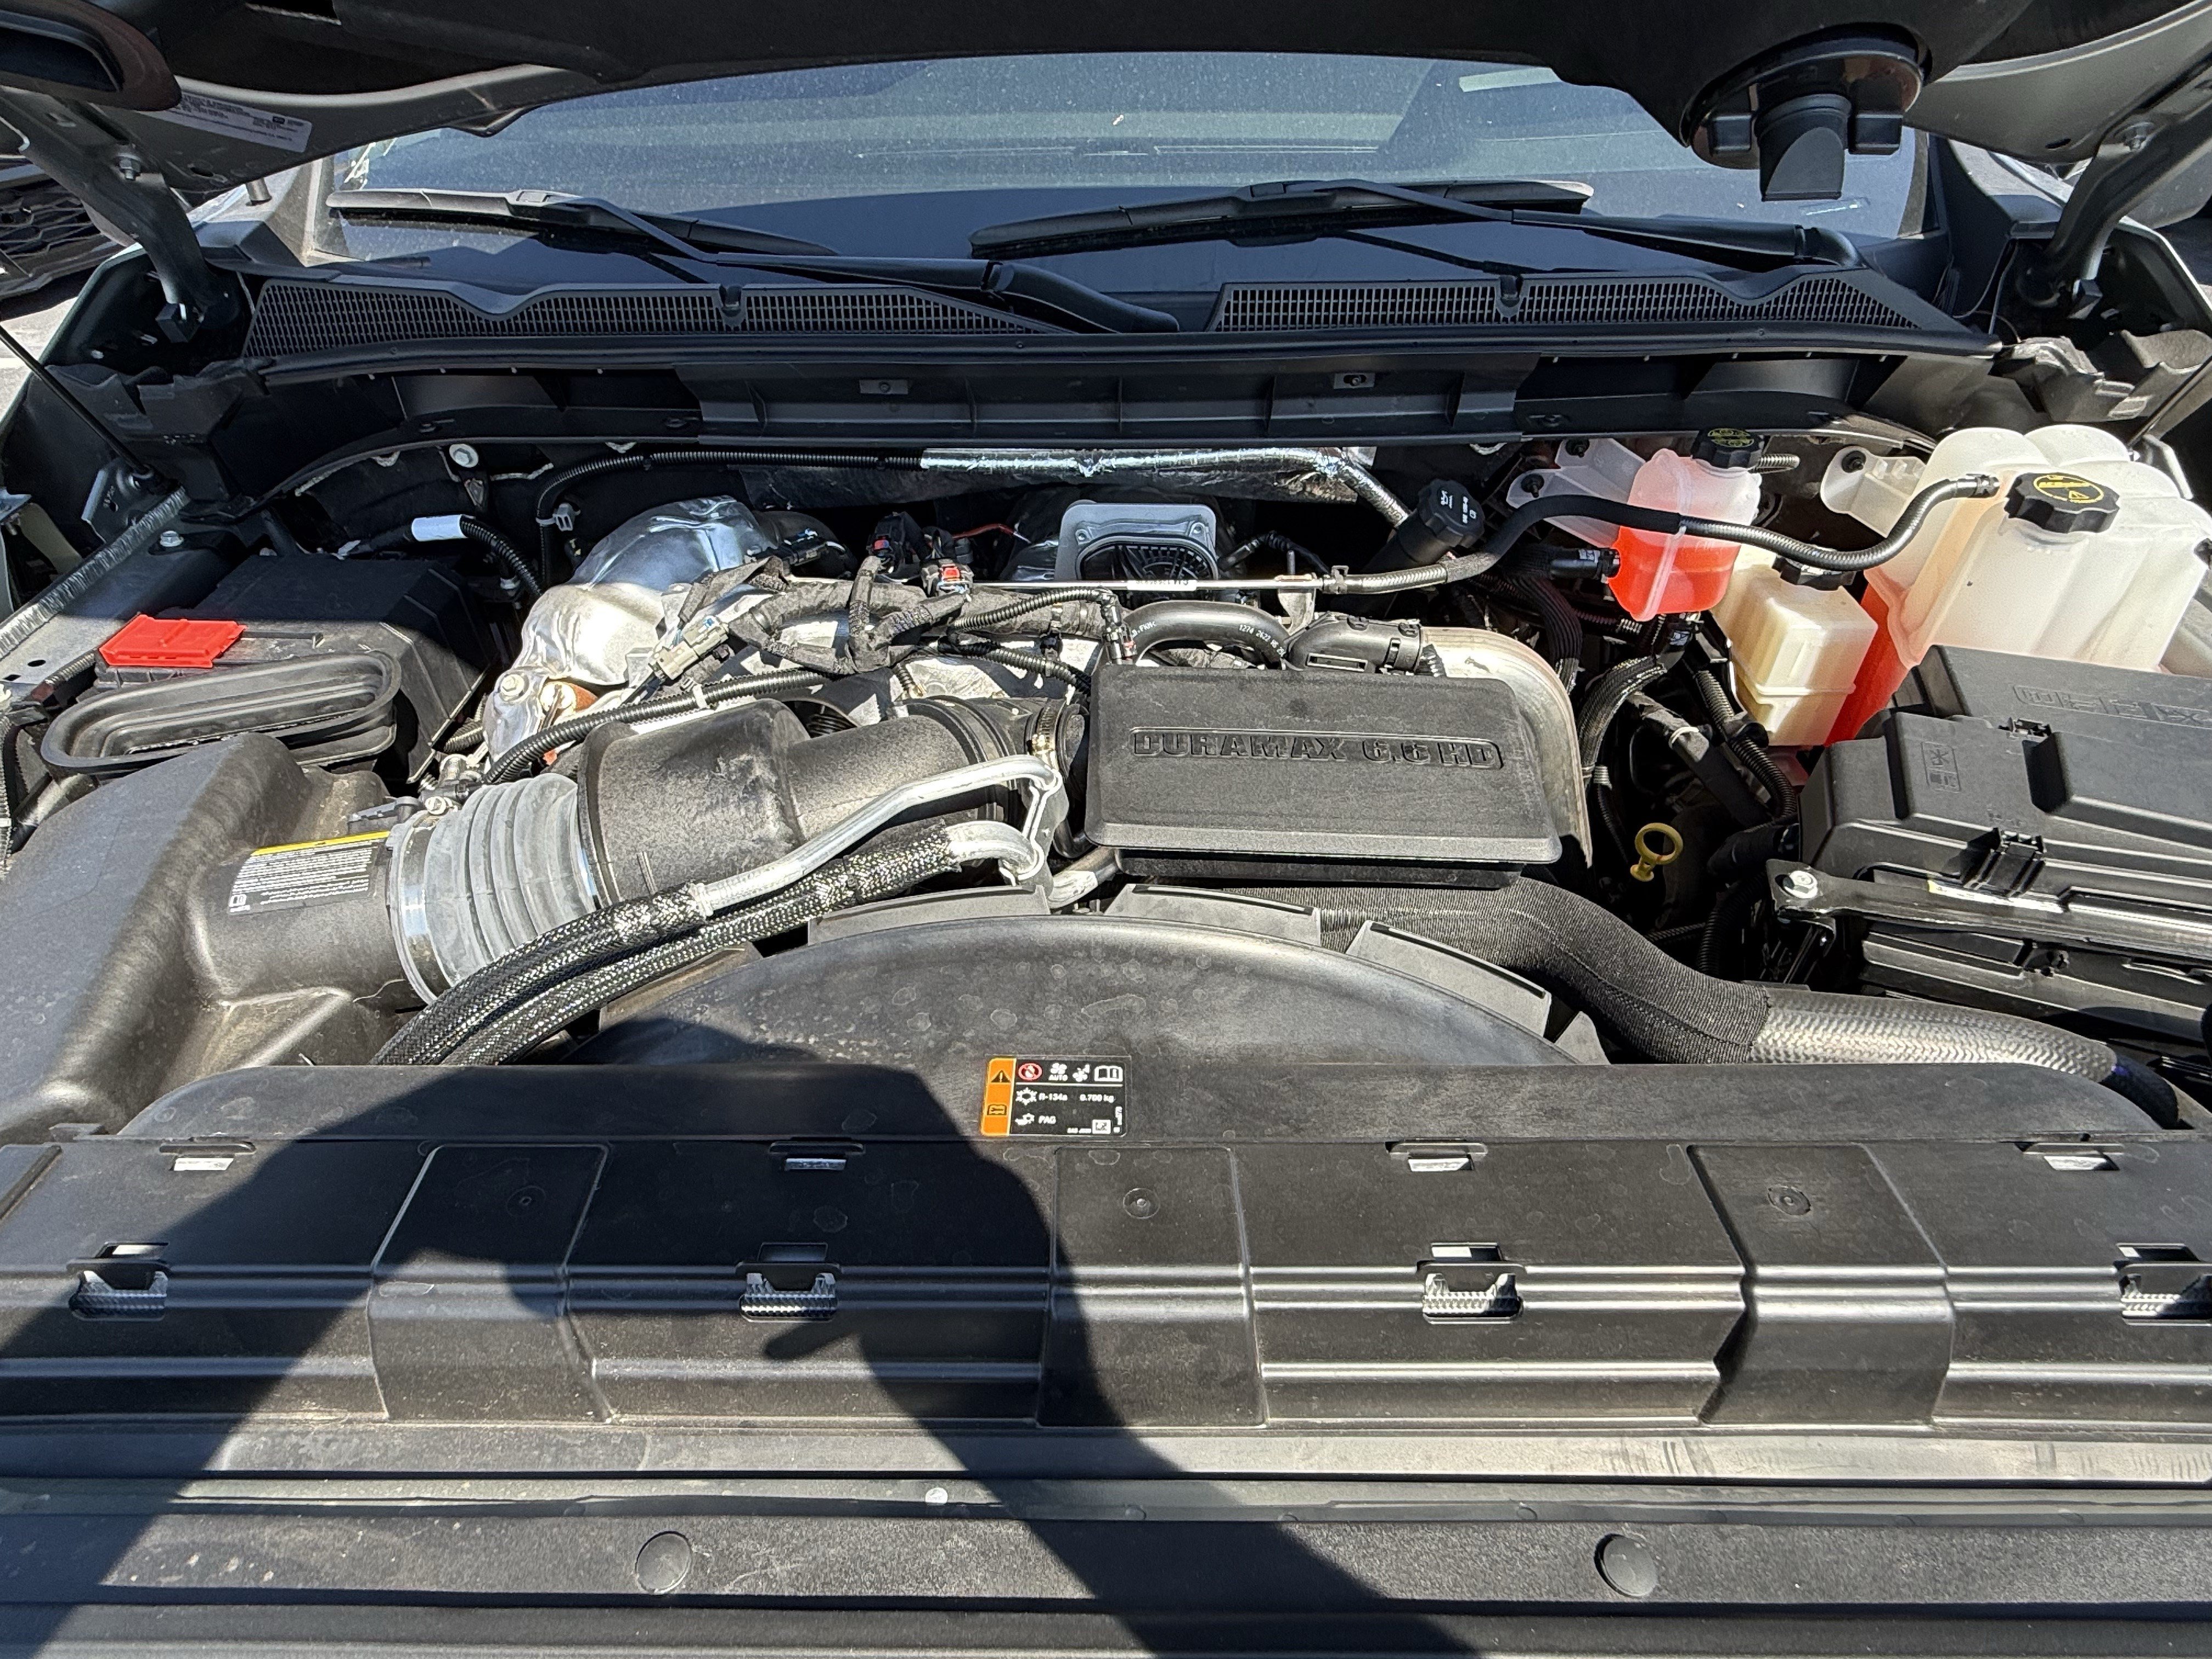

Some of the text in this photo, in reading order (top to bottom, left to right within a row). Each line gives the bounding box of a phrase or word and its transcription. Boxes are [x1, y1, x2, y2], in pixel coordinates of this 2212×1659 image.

[1133, 731, 1499, 768] DURAMAX 6.6 HD
[1038, 1092, 1068, 1101] R-134a
[1103, 1094, 1115, 1103] kg
[1038, 1115, 1057, 1125] PAG
